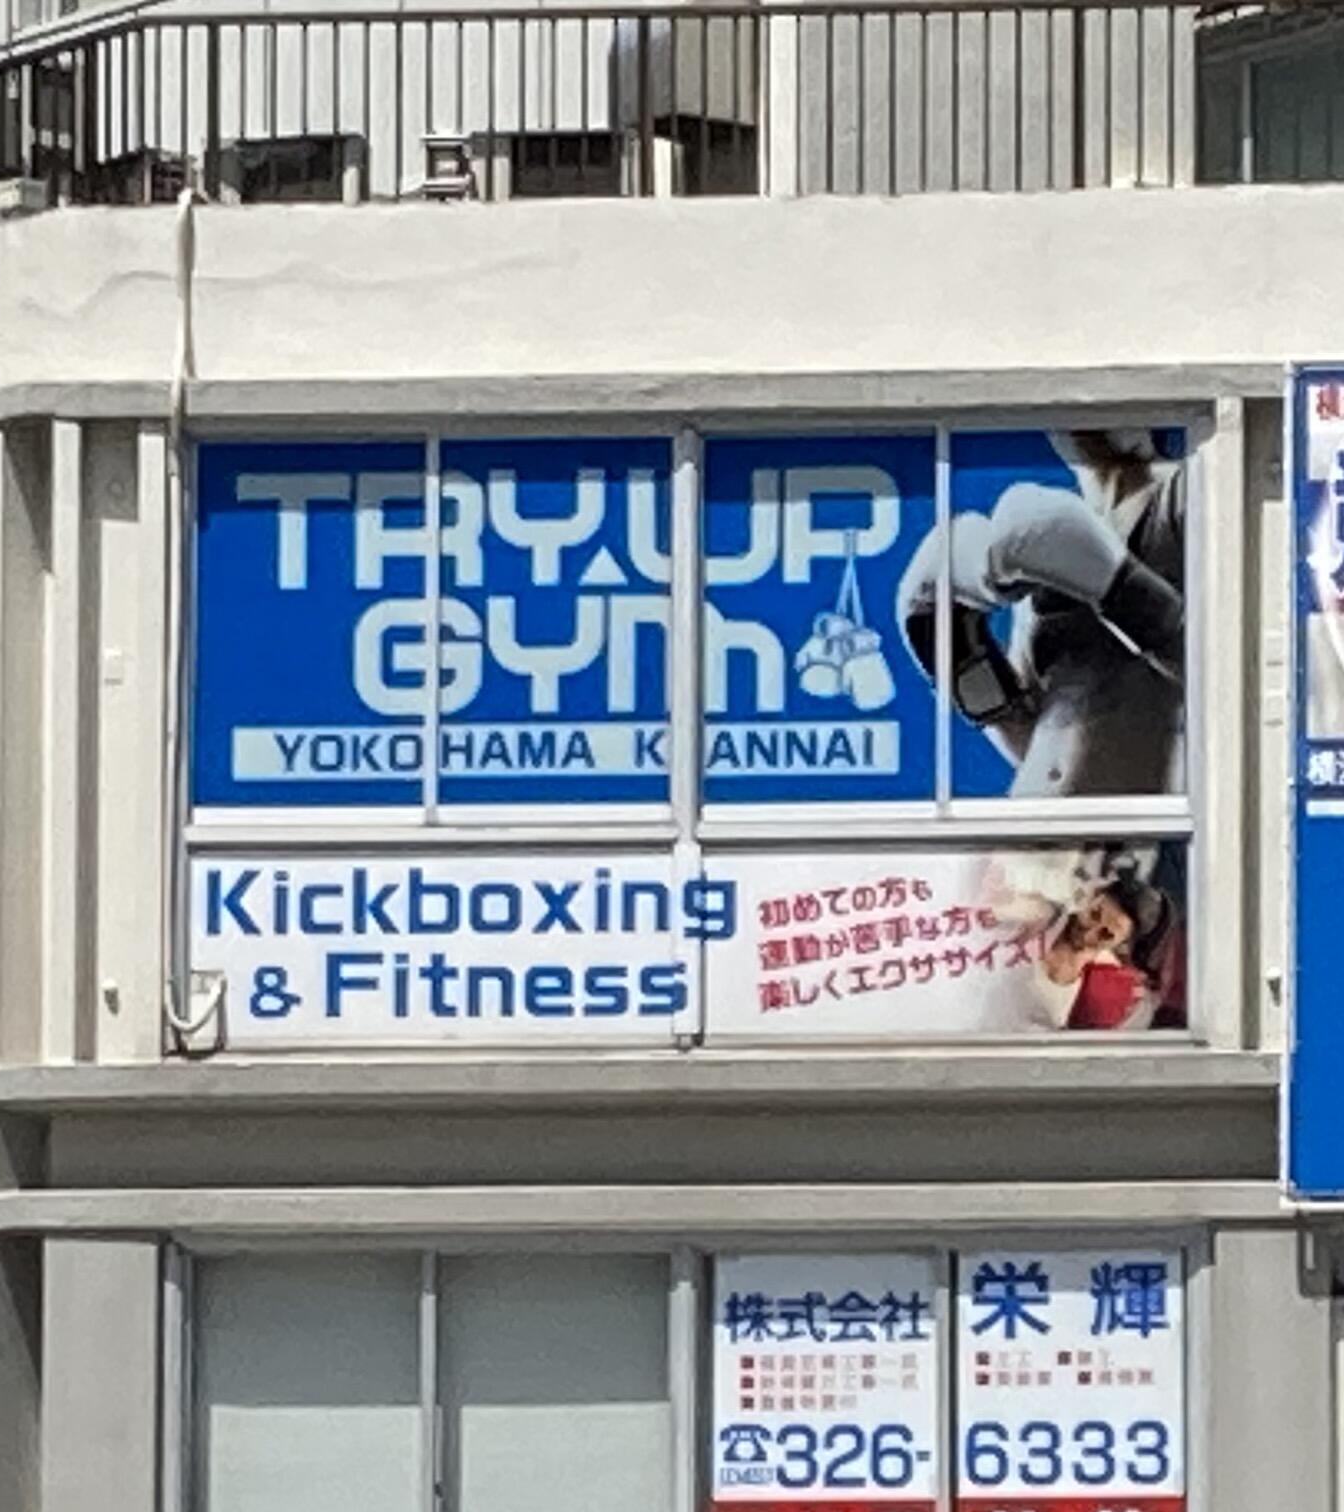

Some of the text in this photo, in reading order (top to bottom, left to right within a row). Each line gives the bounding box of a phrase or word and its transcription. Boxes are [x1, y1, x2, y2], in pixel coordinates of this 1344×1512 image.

[275, 729, 876, 772] YOKOHAMA KANNAI
[205, 868, 739, 942] Kickboxing
[248, 952, 690, 1019] & Fitness
[725, 1292, 931, 1343] 株式会社
[964, 1420, 1170, 1486] 6333
